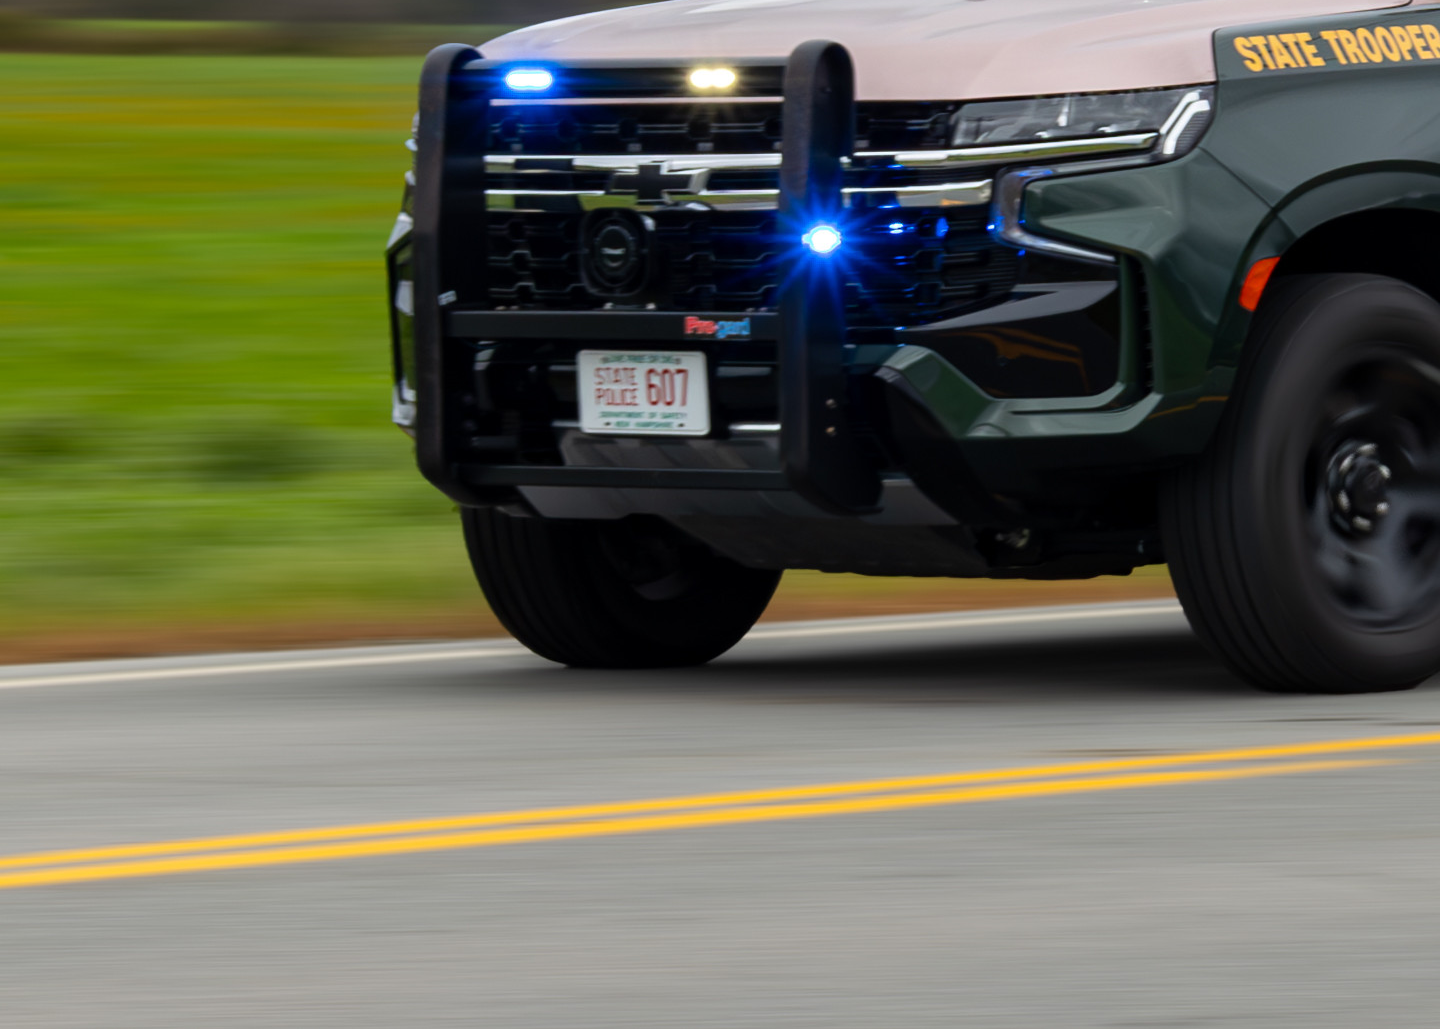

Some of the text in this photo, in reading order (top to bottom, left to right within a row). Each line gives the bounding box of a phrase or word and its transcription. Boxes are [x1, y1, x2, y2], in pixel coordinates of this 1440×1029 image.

[1233, 31, 1327, 73] STATE
[594, 367, 638, 386] STATE
[645, 368, 689, 407] 607
[594, 387, 640, 407] POLICE
